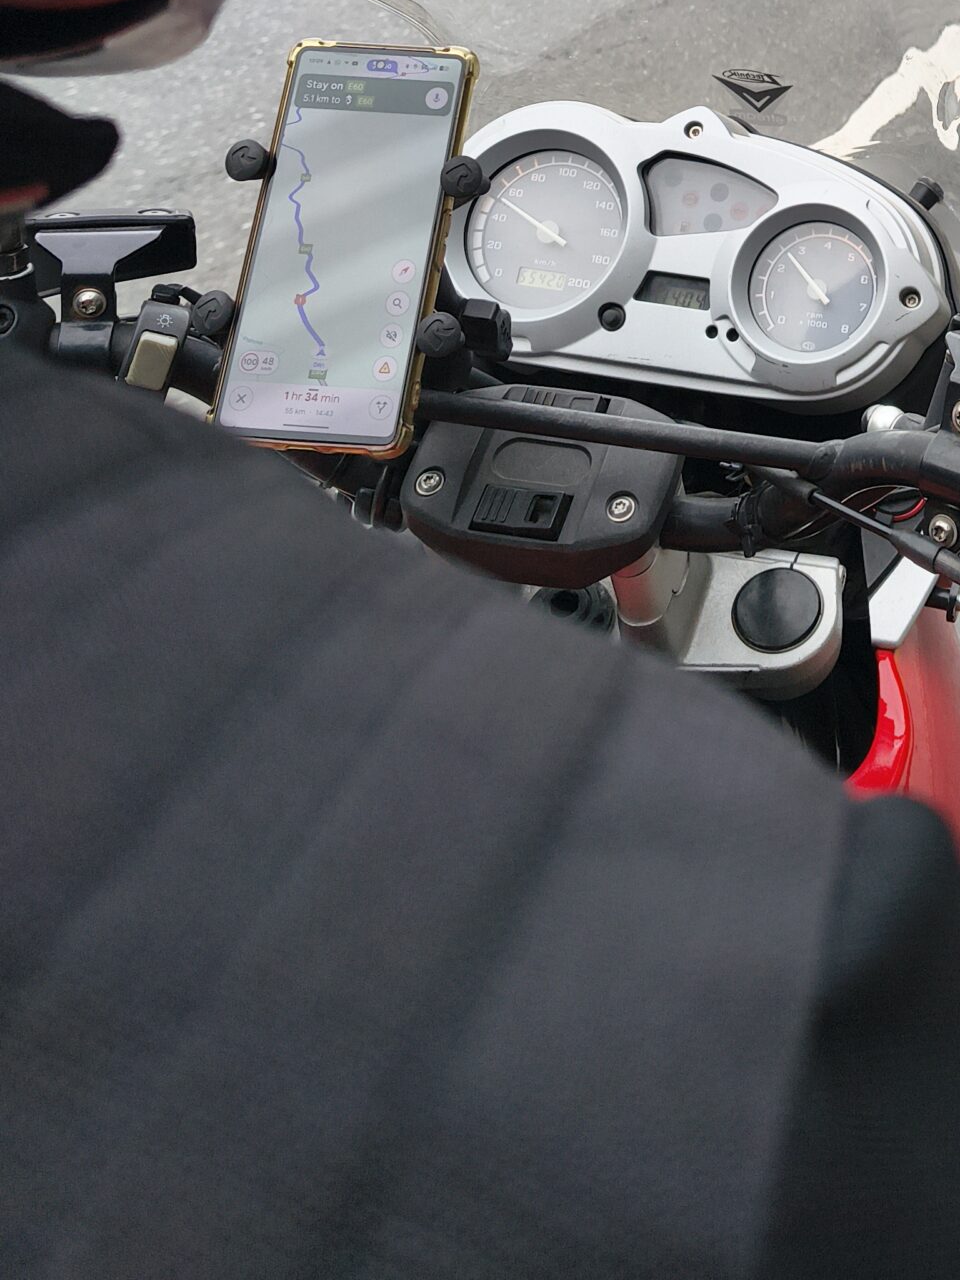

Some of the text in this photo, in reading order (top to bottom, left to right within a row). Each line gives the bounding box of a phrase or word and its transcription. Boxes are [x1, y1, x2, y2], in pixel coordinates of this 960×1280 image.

[306, 80, 364, 91] Stay on E60
[303, 93, 315, 102] 5.1
[316, 94, 329, 103] km
[331, 96, 341, 104] to
[559, 168, 577, 177] 100
[530, 174, 546, 182] 80
[583, 180, 601, 190] 120
[508, 188, 524, 198] 60
[596, 201, 614, 210] 140
[492, 214, 507, 223] 40
[600, 227, 618, 238] 160
[487, 240, 502, 250] 20
[824, 242, 832, 250] 4
[798, 246, 806, 255] 3
[592, 254, 610, 265] 180
[848, 253, 855, 262] 5
[494, 268, 502, 277] 0
[777, 264, 785, 273] 2
[567, 278, 591, 289] 200
[860, 275, 868, 285] 6
[770, 290, 775, 300] 1
[859, 303, 867, 312] 7
[777, 315, 786, 324] 0
[806, 312, 824, 320] rpm
[807, 319, 828, 329] 1000
[840, 324, 850, 334] 8
[262, 357, 275, 366] 48
[284, 391, 340, 403] 1 hr 34 min
